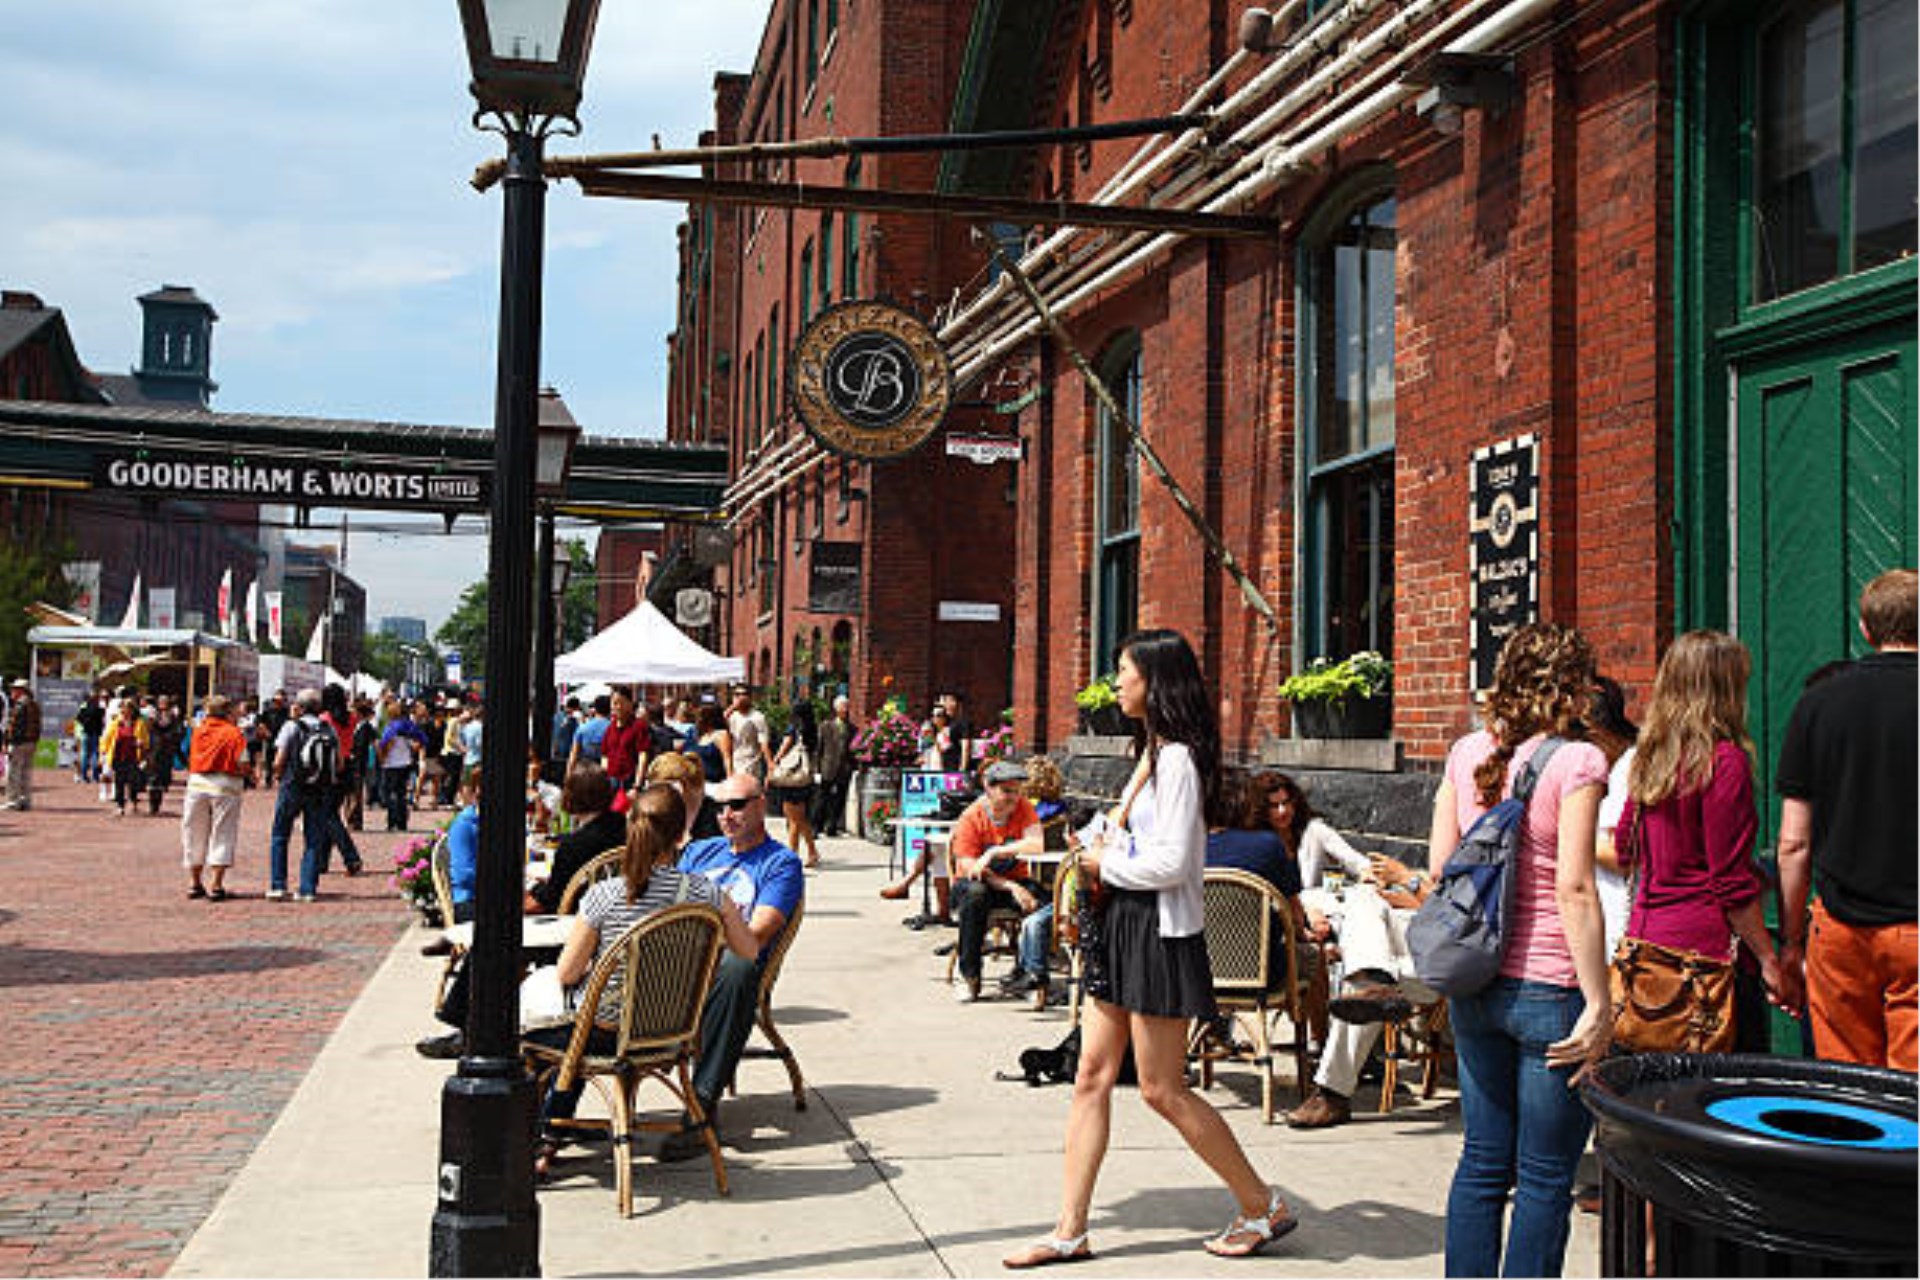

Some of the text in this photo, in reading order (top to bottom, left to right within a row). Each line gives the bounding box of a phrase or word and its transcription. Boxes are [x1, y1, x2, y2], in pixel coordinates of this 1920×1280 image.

[108, 459, 293, 493] GOODERHAM
[302, 468, 325, 495] &
[329, 471, 424, 499] WORTS
